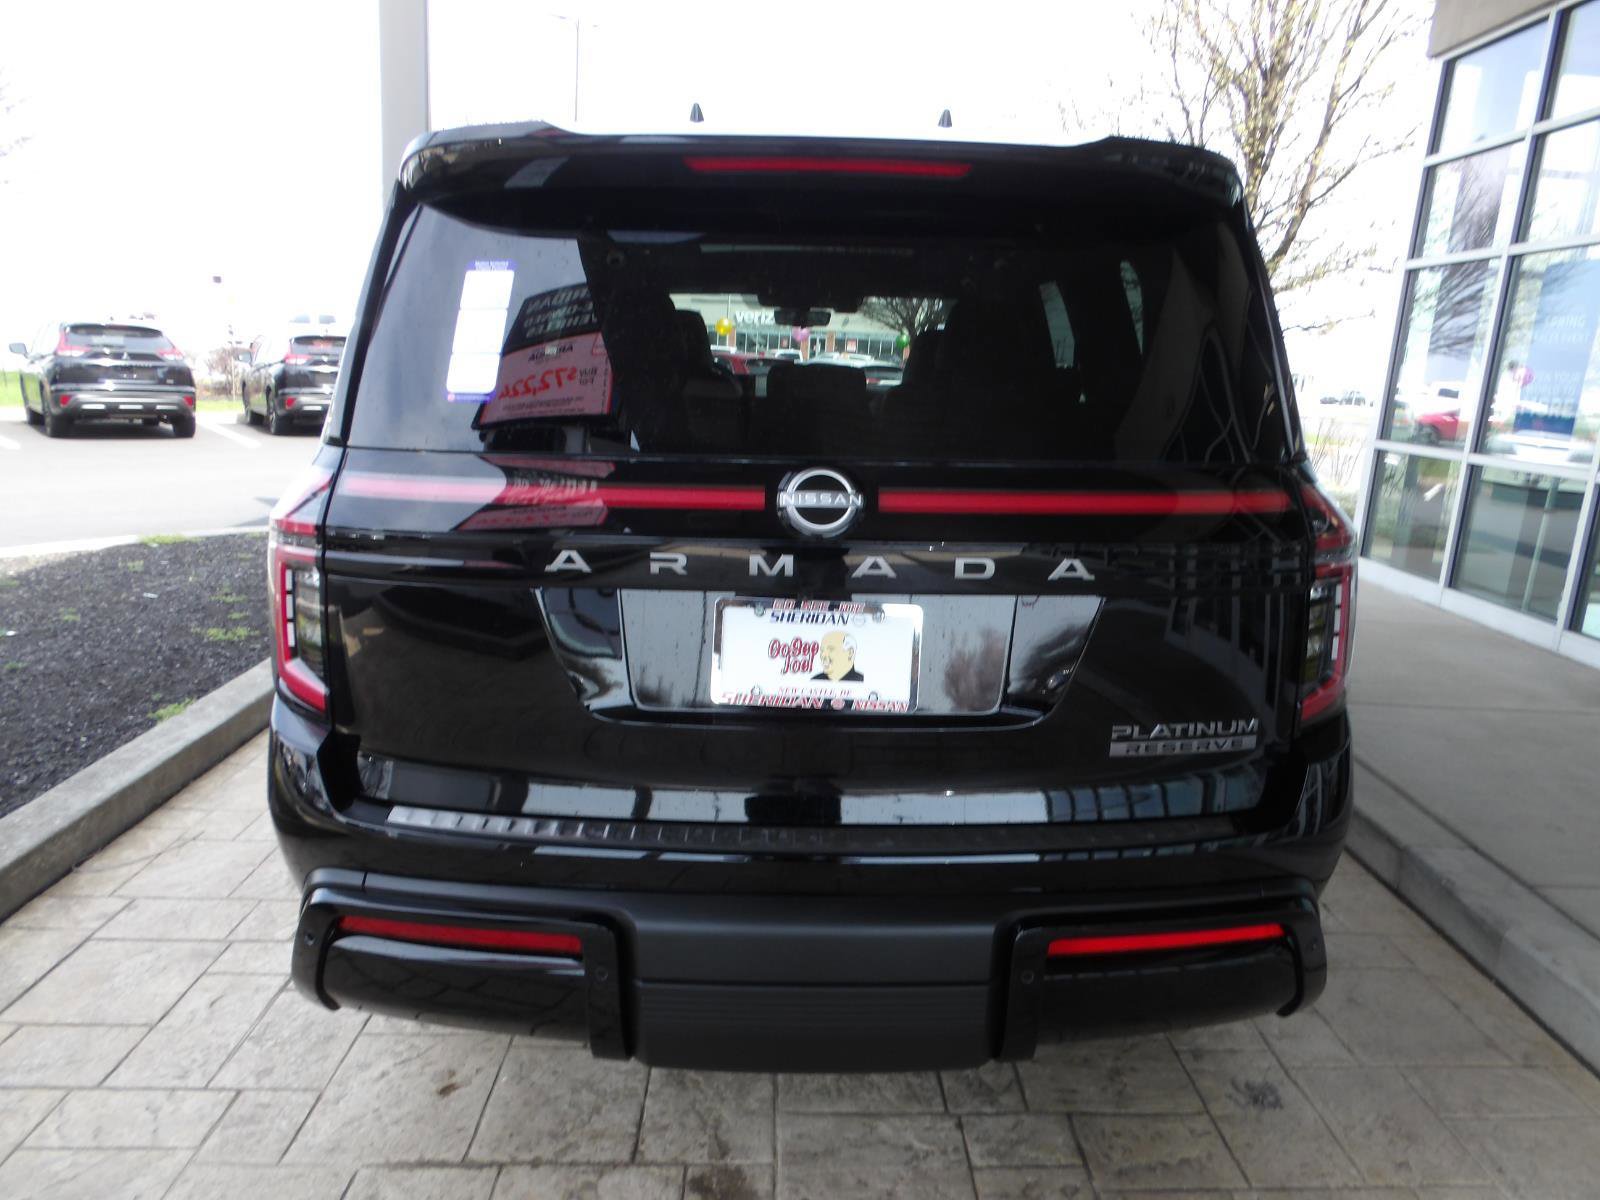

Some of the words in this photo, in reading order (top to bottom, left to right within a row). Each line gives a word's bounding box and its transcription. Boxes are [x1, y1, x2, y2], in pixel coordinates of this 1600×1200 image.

[735, 309, 776, 325] veriz
[781, 492, 862, 507] NISSAN
[544, 550, 1096, 582] ARMADA
[769, 611, 850, 625] SHERIDAN
[722, 692, 824, 710] SHERIDAN
[851, 699, 909, 712] NISSAN
[1111, 718, 1259, 740] PLATINUM
[1126, 737, 1244, 755] RESERVE
